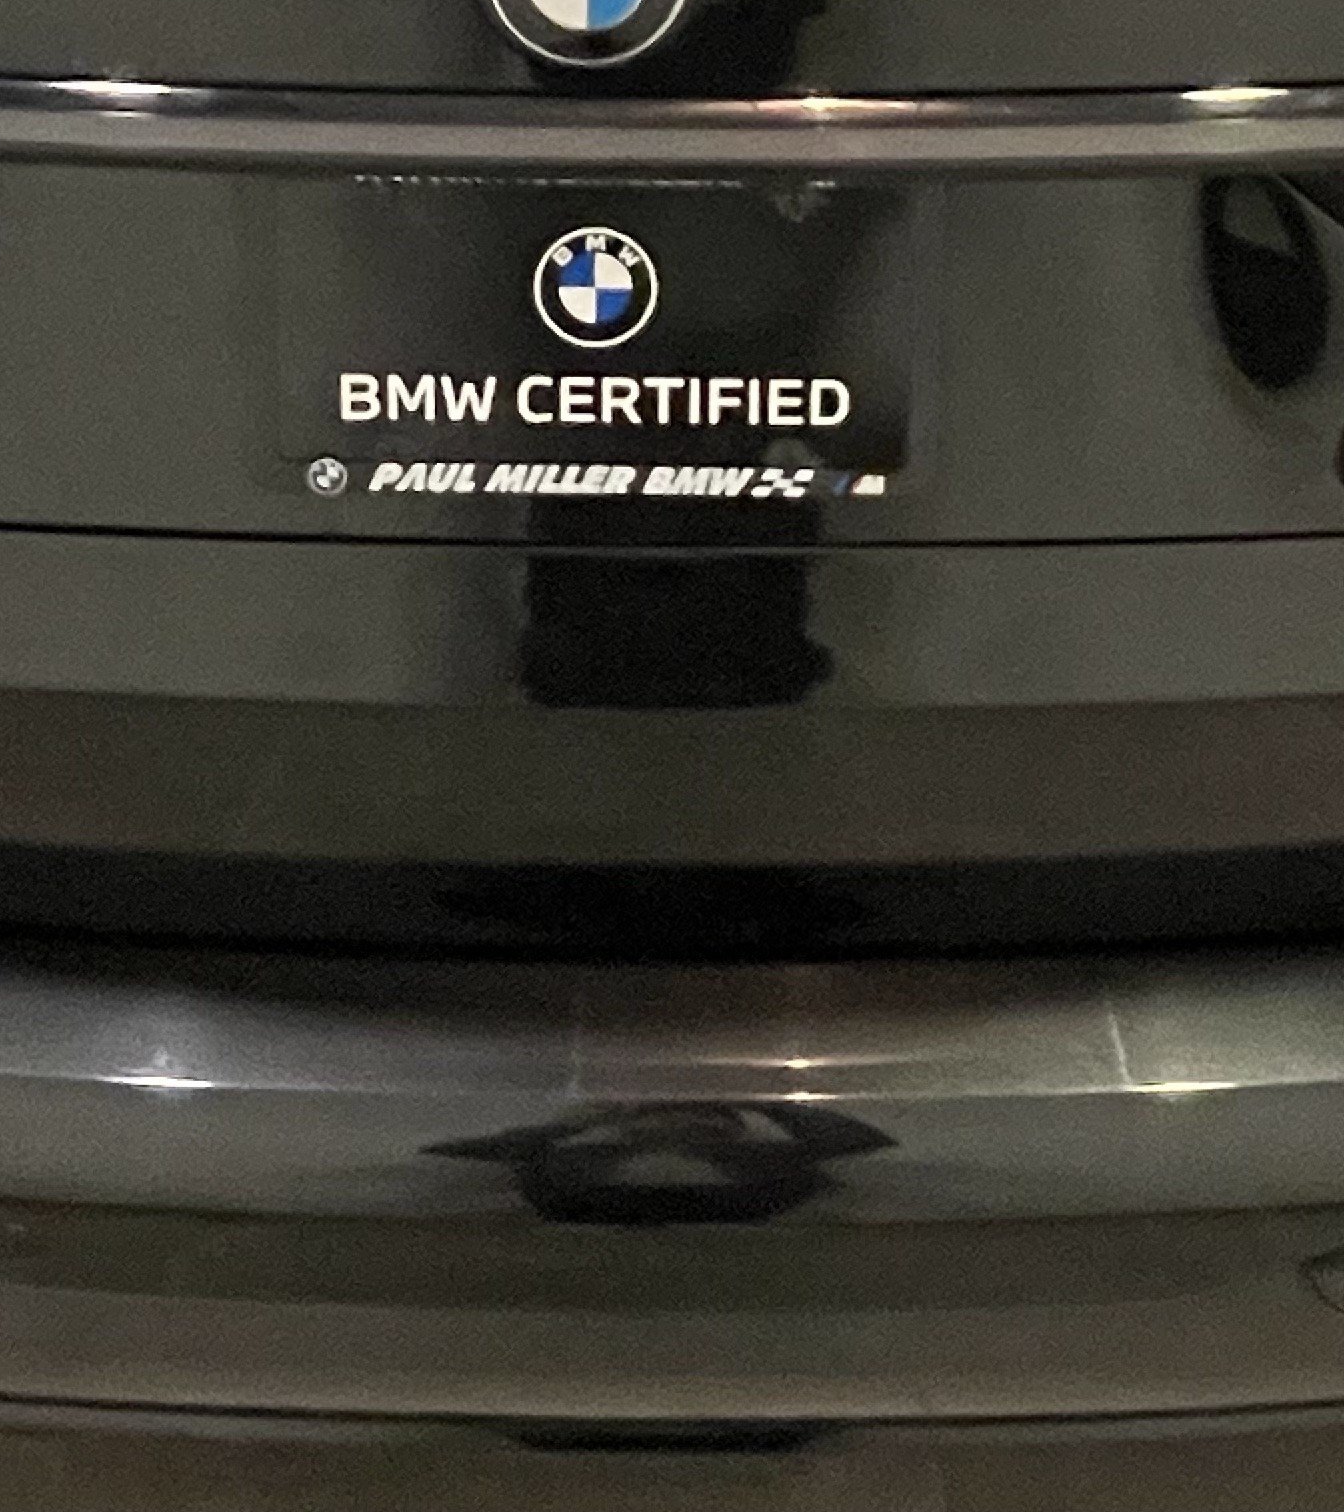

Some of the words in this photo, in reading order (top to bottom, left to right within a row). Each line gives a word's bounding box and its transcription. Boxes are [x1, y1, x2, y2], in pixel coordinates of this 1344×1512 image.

[552, 232, 640, 268] BMW
[339, 372, 497, 422] BMW
[516, 376, 850, 426] CERTIFIED
[368, 461, 476, 493] PAUL
[483, 462, 636, 494] MILLER
[641, 466, 755, 497] BMW
